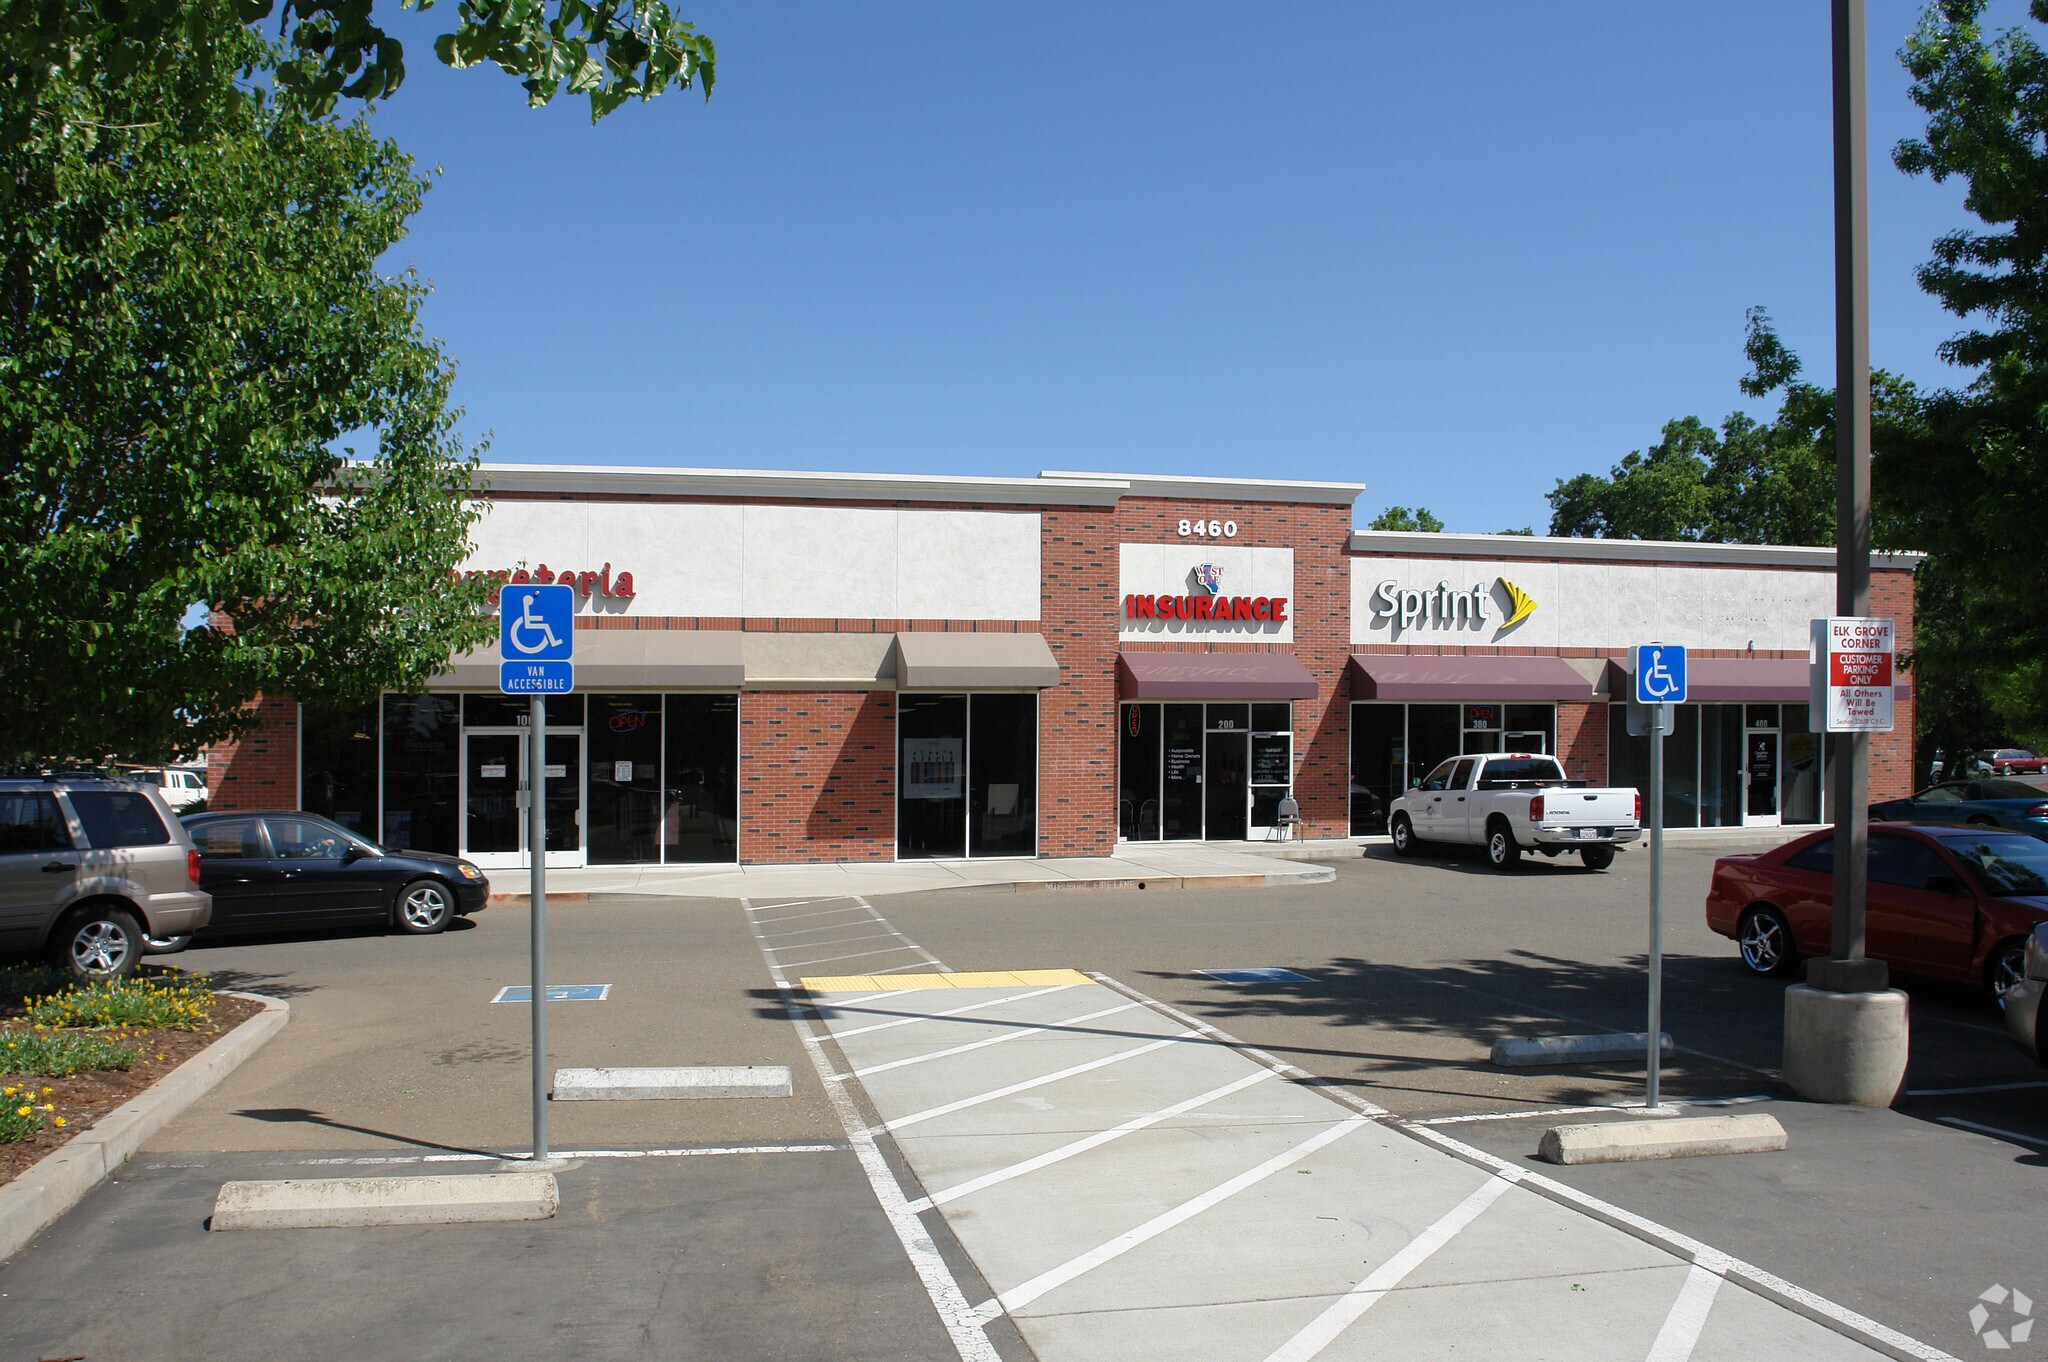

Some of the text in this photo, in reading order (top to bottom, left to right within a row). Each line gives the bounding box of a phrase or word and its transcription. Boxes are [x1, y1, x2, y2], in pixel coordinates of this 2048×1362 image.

[1177, 519, 1238, 538] 8460
[1195, 566, 1223, 576] WEST
[1198, 575, 1220, 585] ONE
[1124, 594, 1288, 621] INSURANCE
[1378, 579, 1491, 629] Sprint
[1833, 626, 1888, 637] ELK GROVE
[1841, 638, 1881, 648] CORNER
[1839, 654, 1882, 665] CUSTOMER
[527, 666, 545, 677] VAN
[1843, 665, 1879, 675] PARKING
[507, 679, 565, 690] ACCESSIBLE
[1849, 675, 1872, 685] ONLY
[1839, 689, 1882, 698] All Others
[1846, 698, 1876, 707] Will Be
[1470, 708, 1493, 718] OPEN
[1847, 707, 1875, 716] Towed
[516, 715, 530, 726] 10
[608, 715, 646, 729] OPEN
[1218, 719, 1234, 730] 200
[1472, 720, 1488, 729] 300
[1755, 719, 1768, 728] 400
